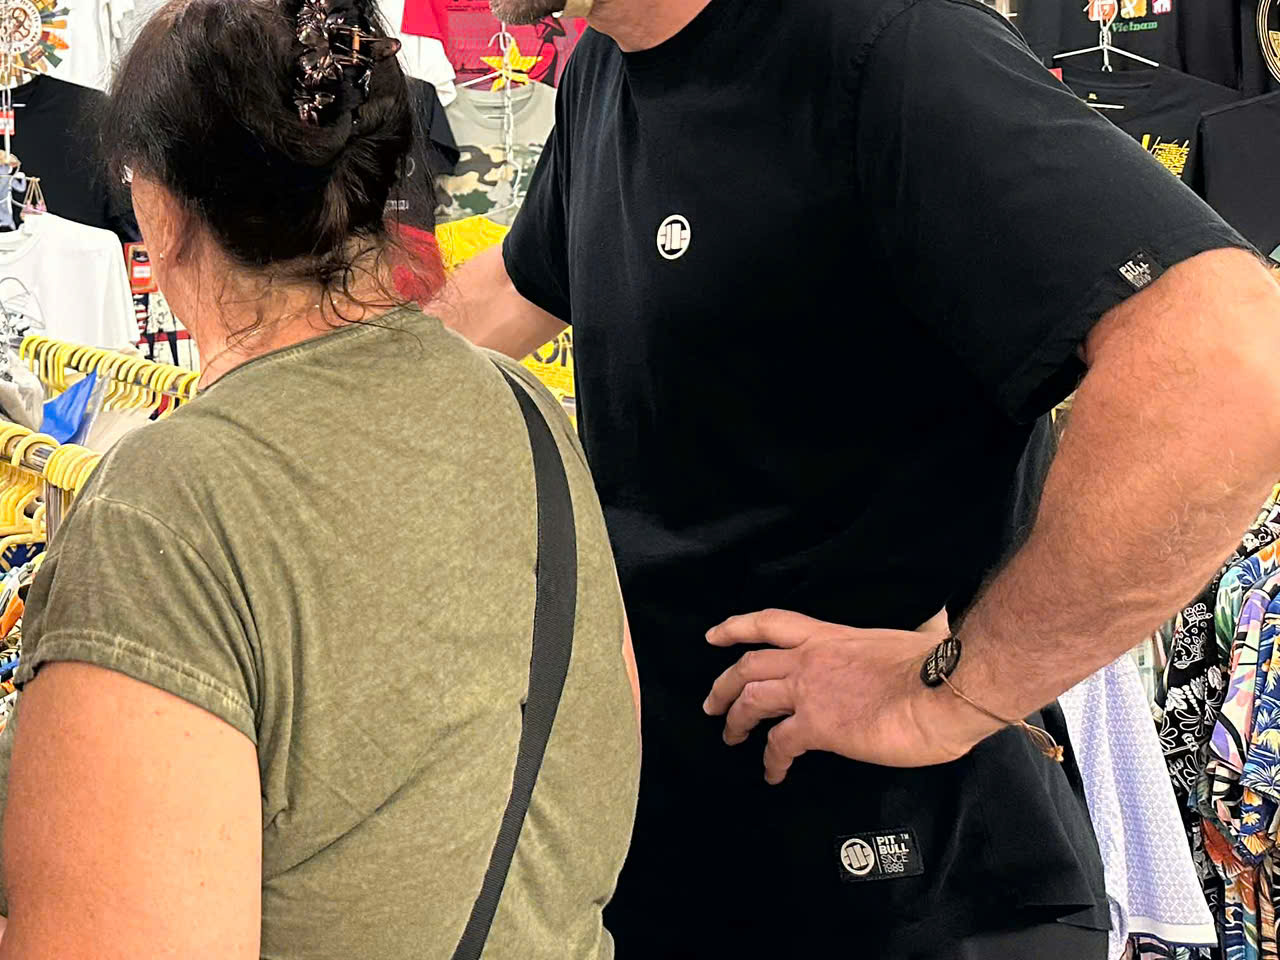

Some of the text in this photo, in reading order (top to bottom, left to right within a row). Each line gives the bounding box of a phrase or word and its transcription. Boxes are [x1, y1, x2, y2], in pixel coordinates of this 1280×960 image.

[875, 835, 896, 846] PIT
[878, 842, 910, 856] BULL
[882, 862, 905, 874] 1989
